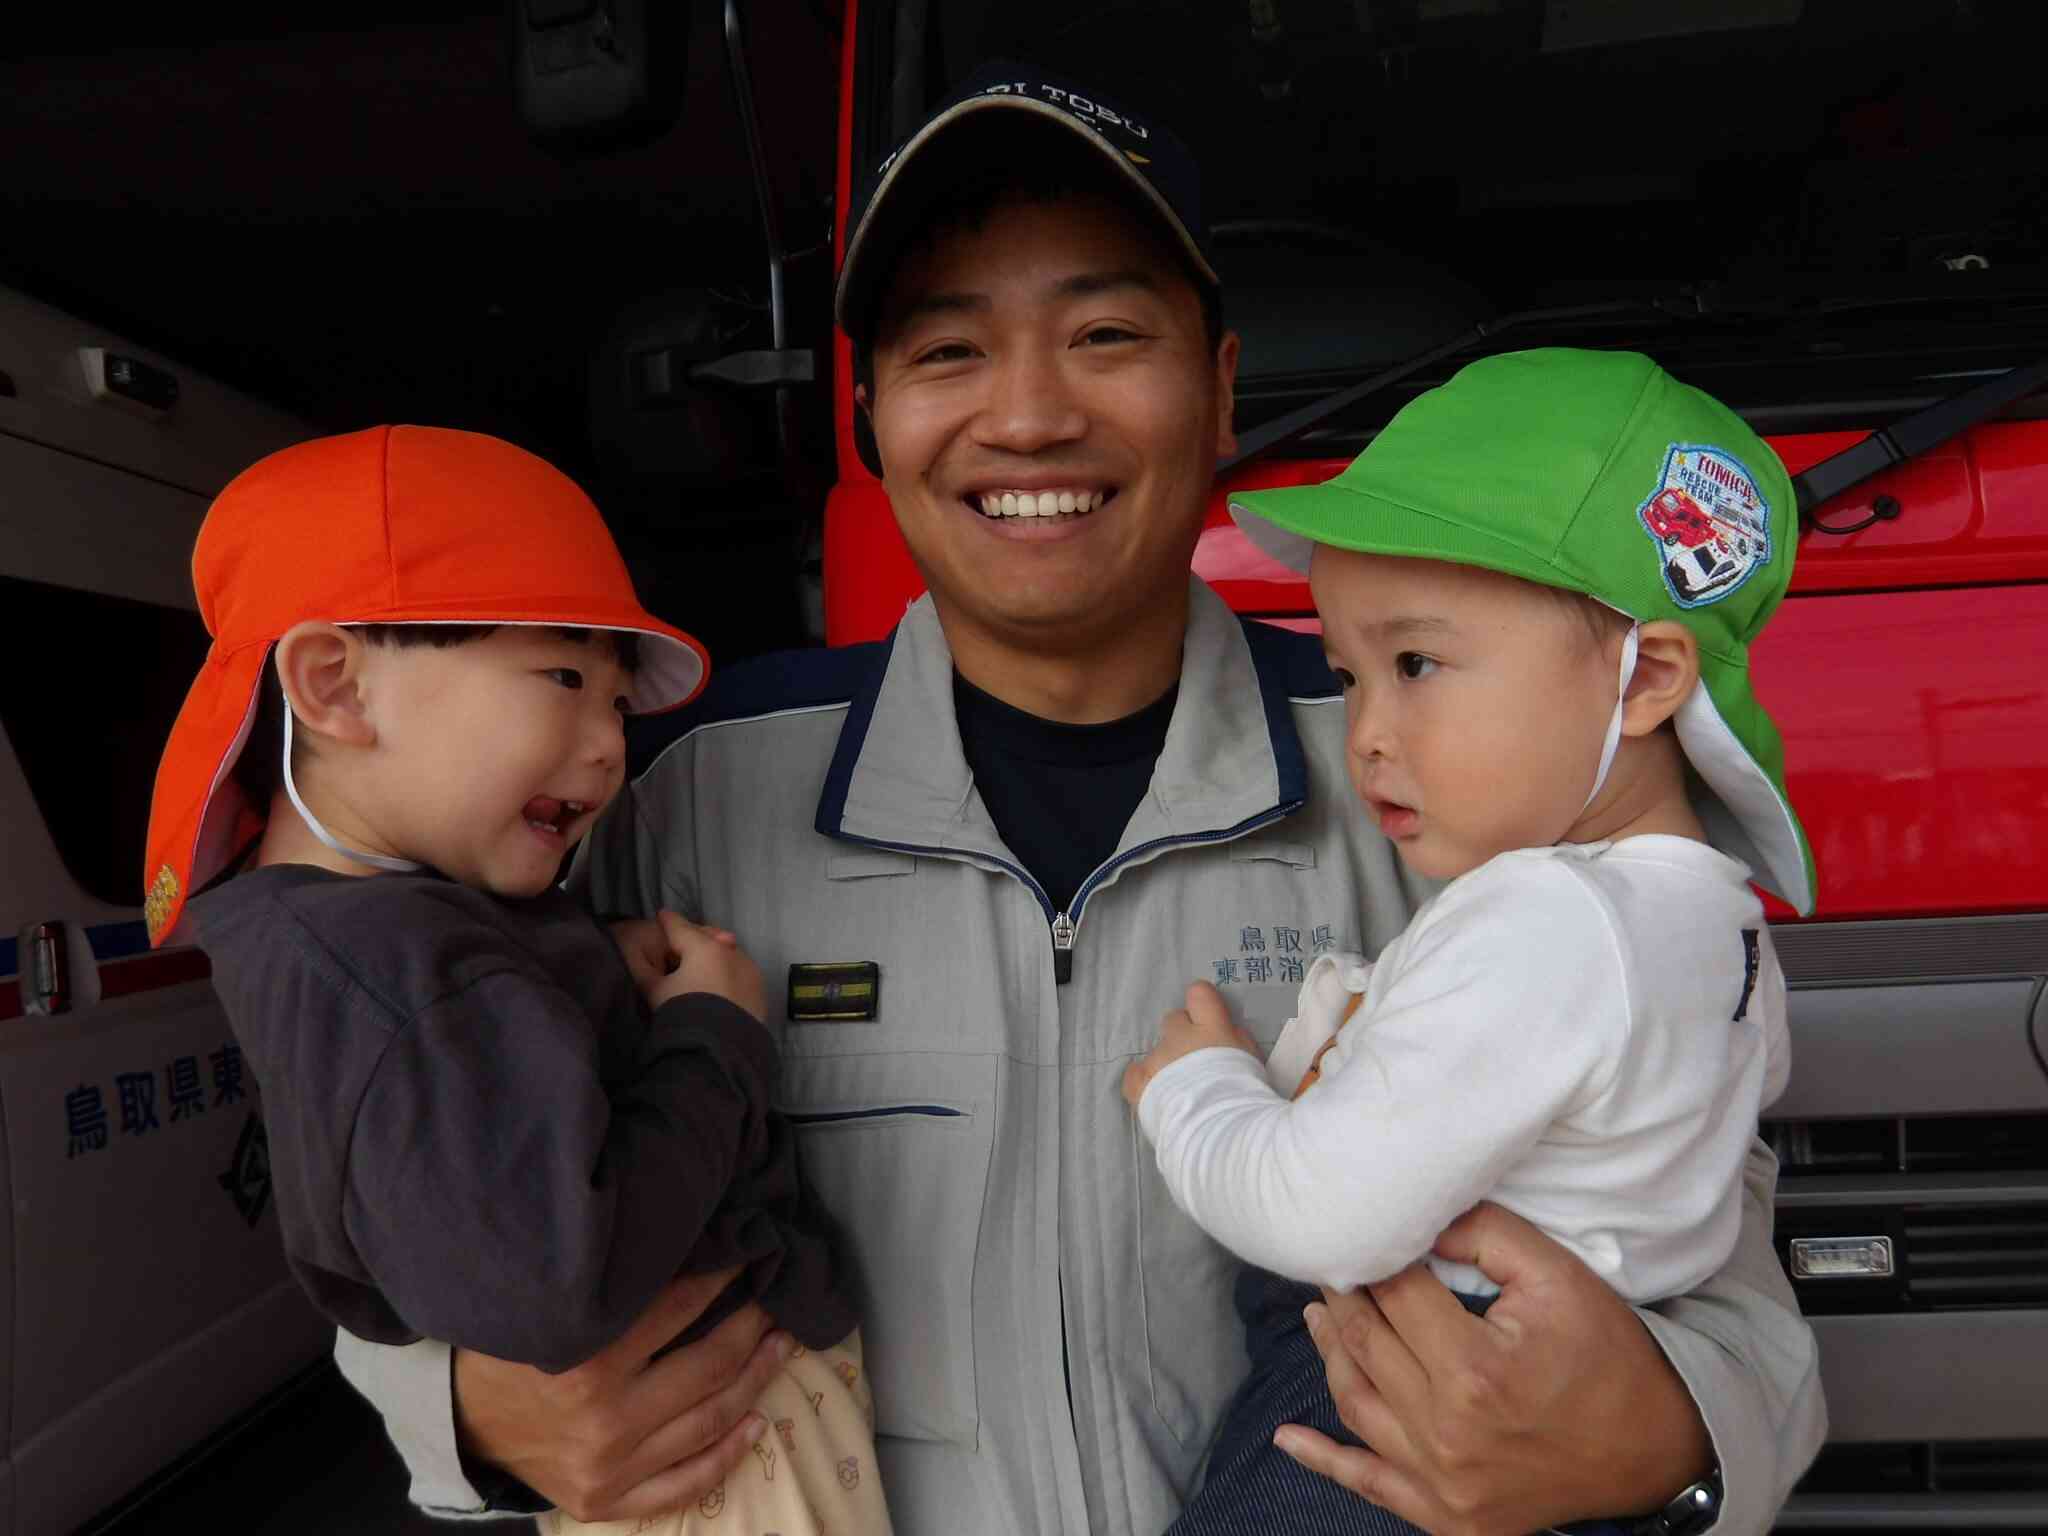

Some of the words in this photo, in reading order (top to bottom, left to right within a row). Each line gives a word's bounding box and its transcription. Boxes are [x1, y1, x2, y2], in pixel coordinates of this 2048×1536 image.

[1041, 84, 1149, 138] TOBU
[1680, 467, 1721, 497] RESCUE
[1685, 482, 1713, 505] TEAM
[1698, 455, 1752, 502] TOMICA
[1240, 924, 1335, 953] 鳥取県
